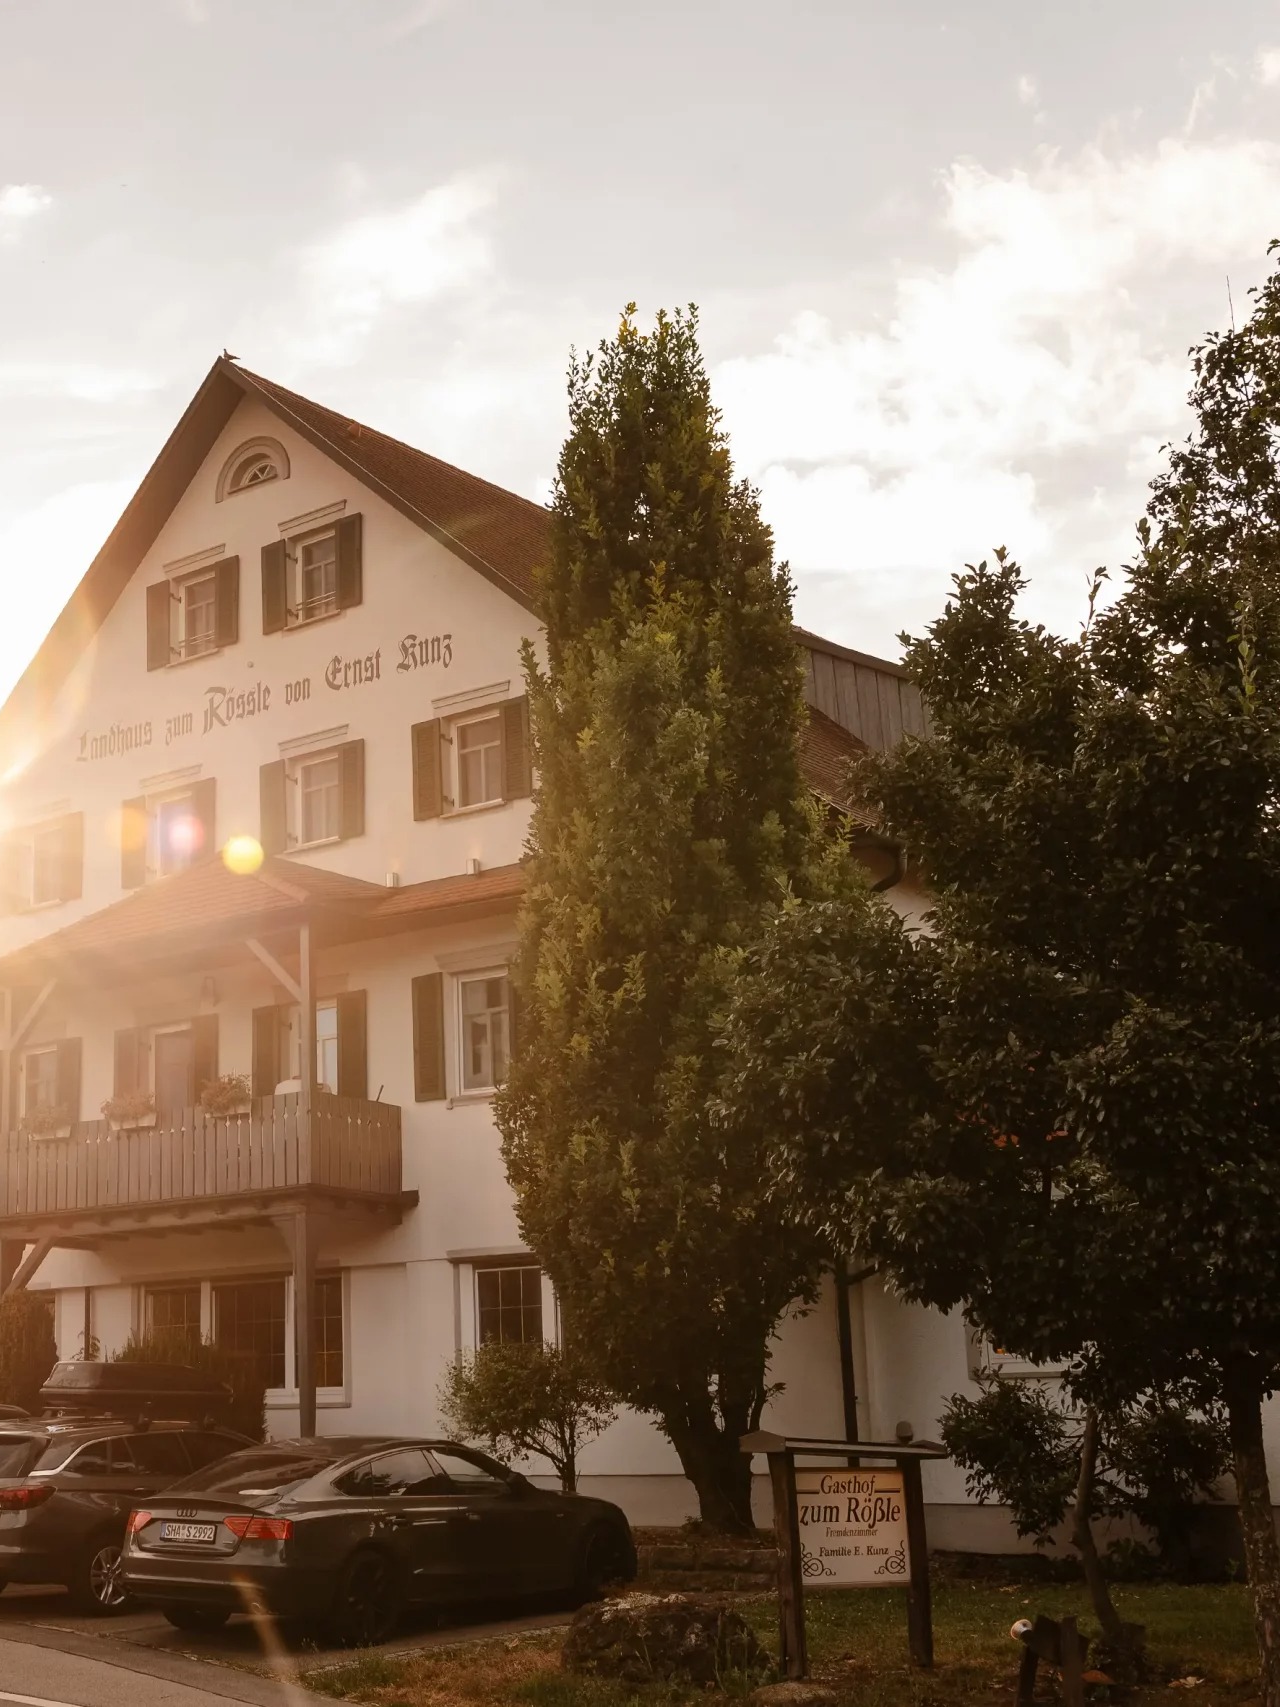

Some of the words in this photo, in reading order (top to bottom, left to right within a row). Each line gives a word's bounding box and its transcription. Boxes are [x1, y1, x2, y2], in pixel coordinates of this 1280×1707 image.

[76, 721, 153, 762] Landhaus
[165, 711, 193, 746] zum
[202, 681, 271, 736] Rössle
[284, 677, 312, 706] von
[325, 647, 381, 691] Ernst
[396, 633, 453, 674] Kunz
[820, 1475, 876, 1496] Gasthof
[799, 1505, 840, 1526] zum
[845, 1497, 901, 1529] Rößle
[166, 1524, 180, 1537] SHA
[192, 1526, 214, 1539] 2992
[825, 1527, 878, 1538] Fremdenzimmer
[819, 1546, 852, 1557] Familie
[854, 1547, 864, 1556] E.
[866, 1545, 889, 1556] Kunz
